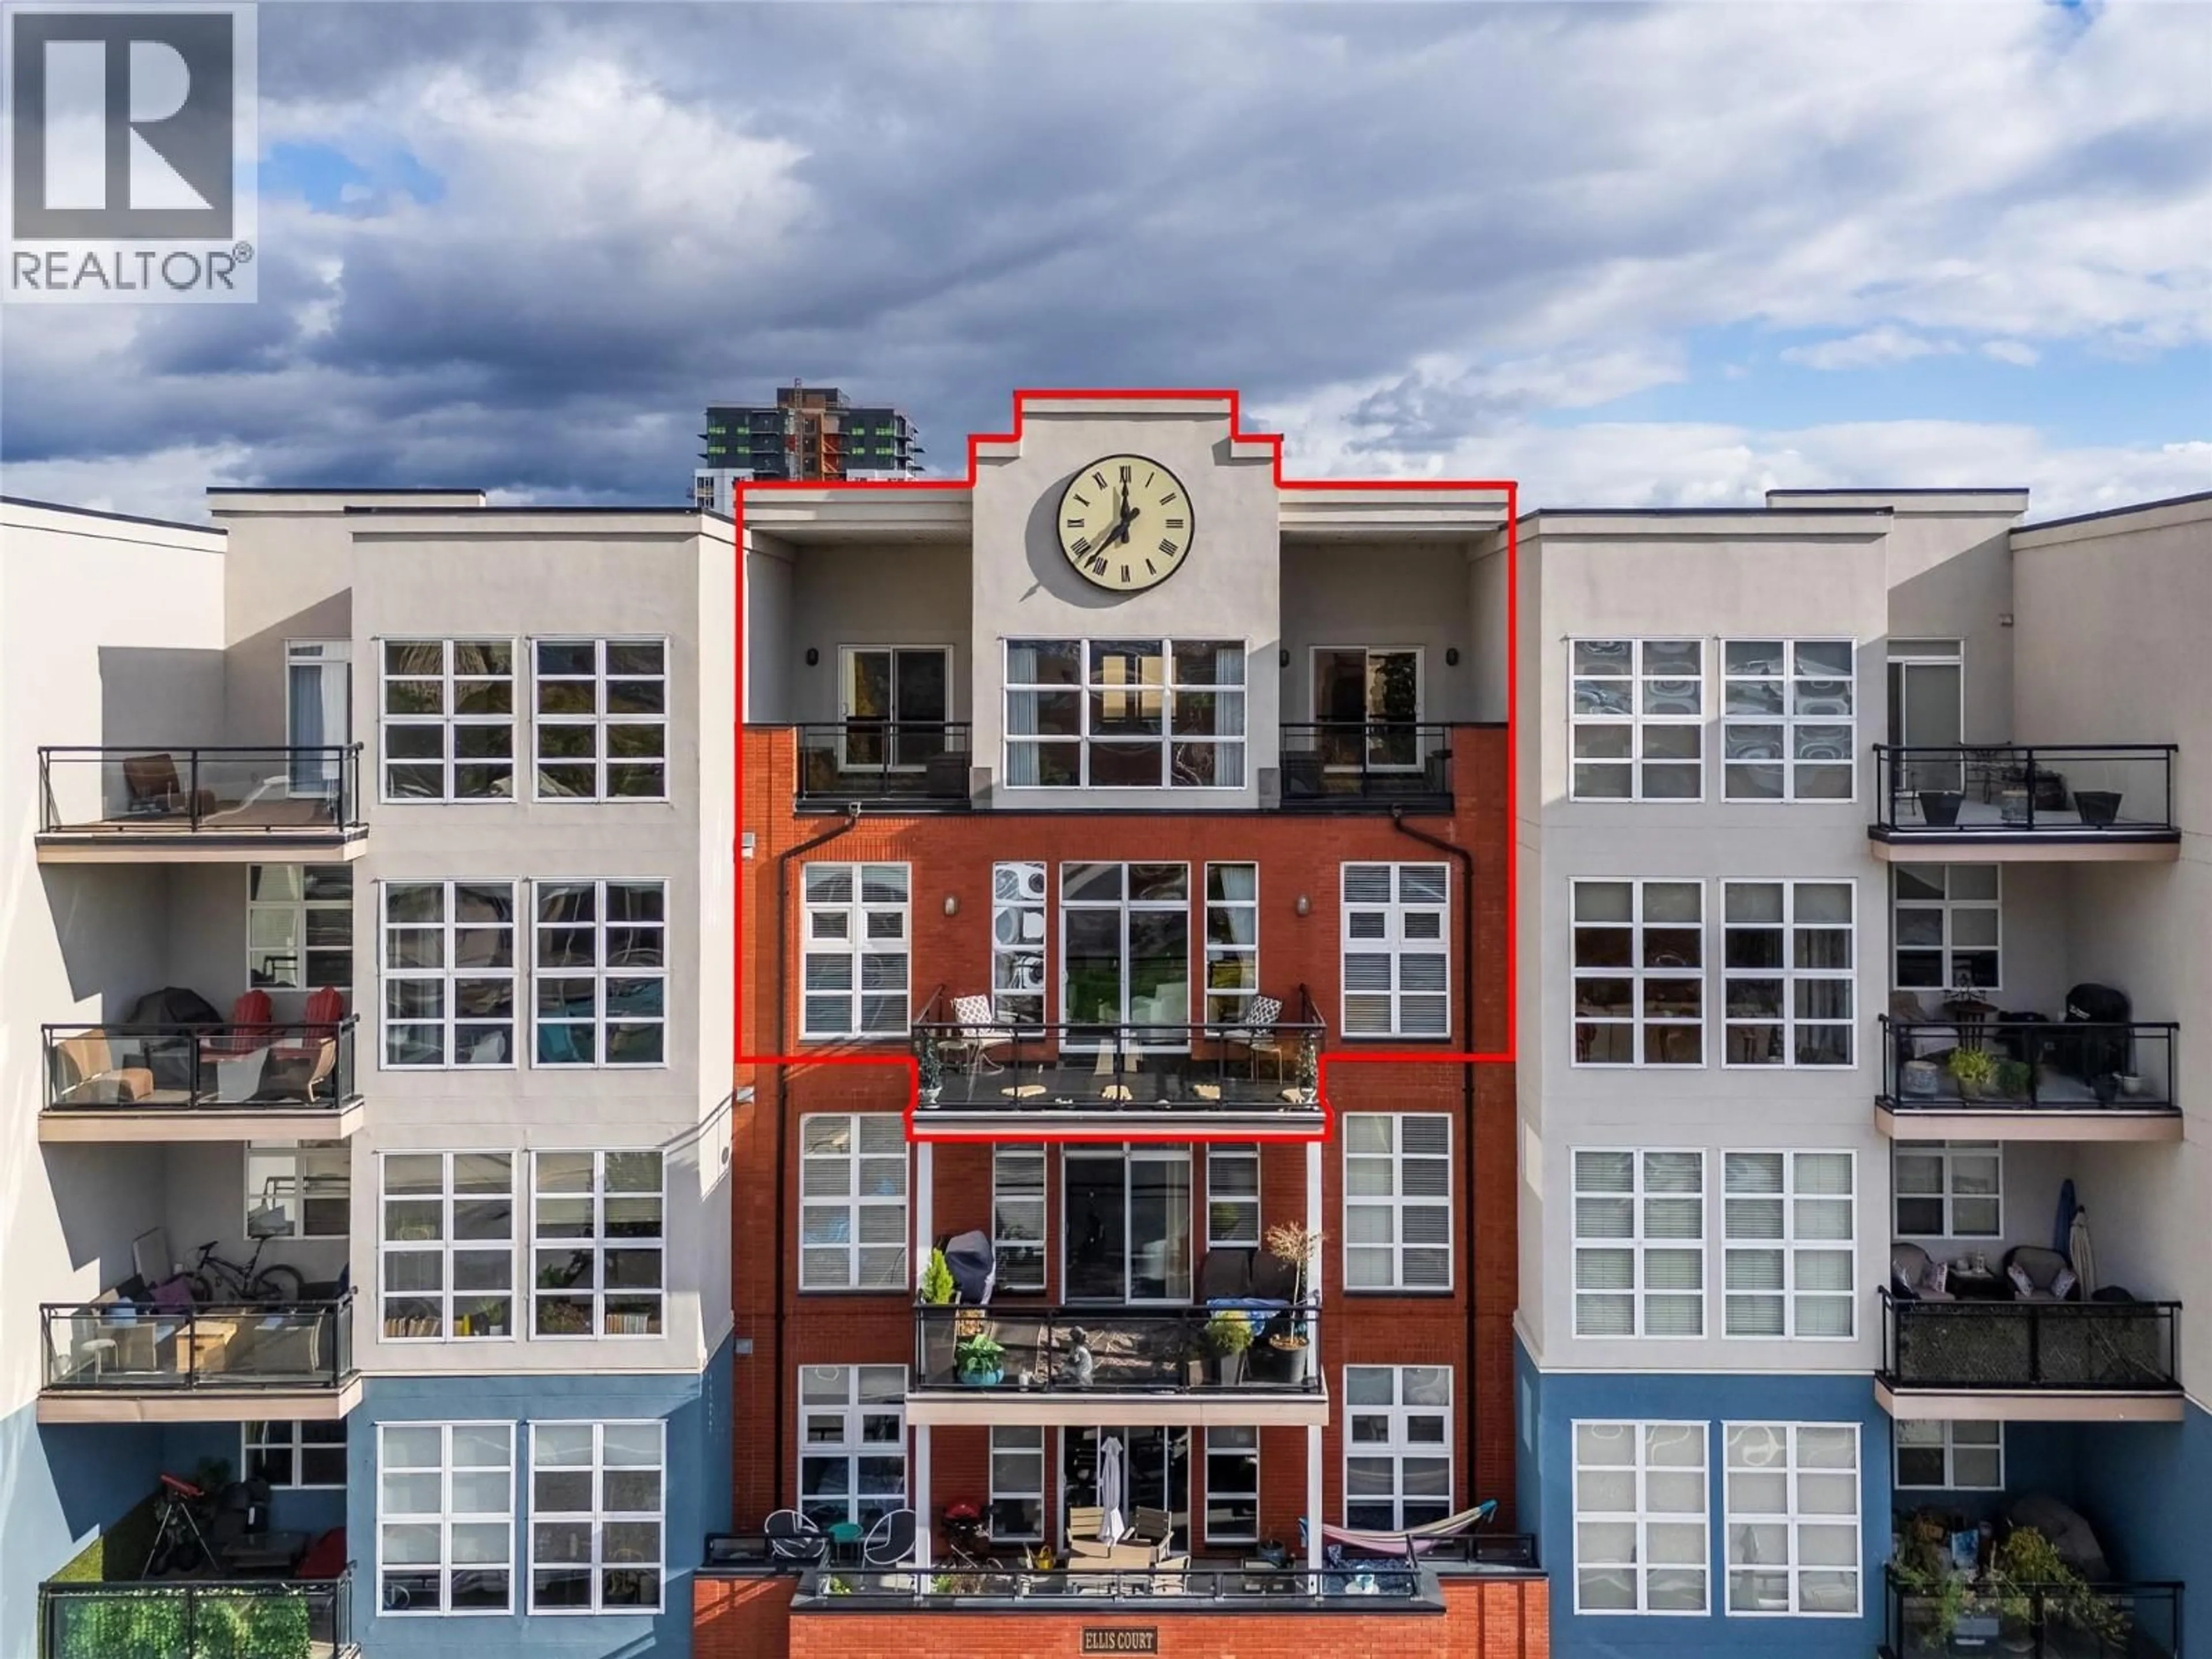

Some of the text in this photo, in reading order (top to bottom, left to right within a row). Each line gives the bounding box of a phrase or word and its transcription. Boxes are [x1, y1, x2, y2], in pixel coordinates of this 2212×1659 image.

[1092, 471, 1108, 491] XI
[1119, 465, 1131, 483] XII
[1145, 472, 1155, 488] I
[1073, 494, 1090, 507] X
[1159, 492, 1177, 506] II
[1067, 518, 1084, 528] IX
[1165, 519, 1184, 528] III
[1121, 565, 1130, 582] VI
[1145, 558, 1157, 575] V
[1086, 1633, 1153, 1649] ELLIS COURT
